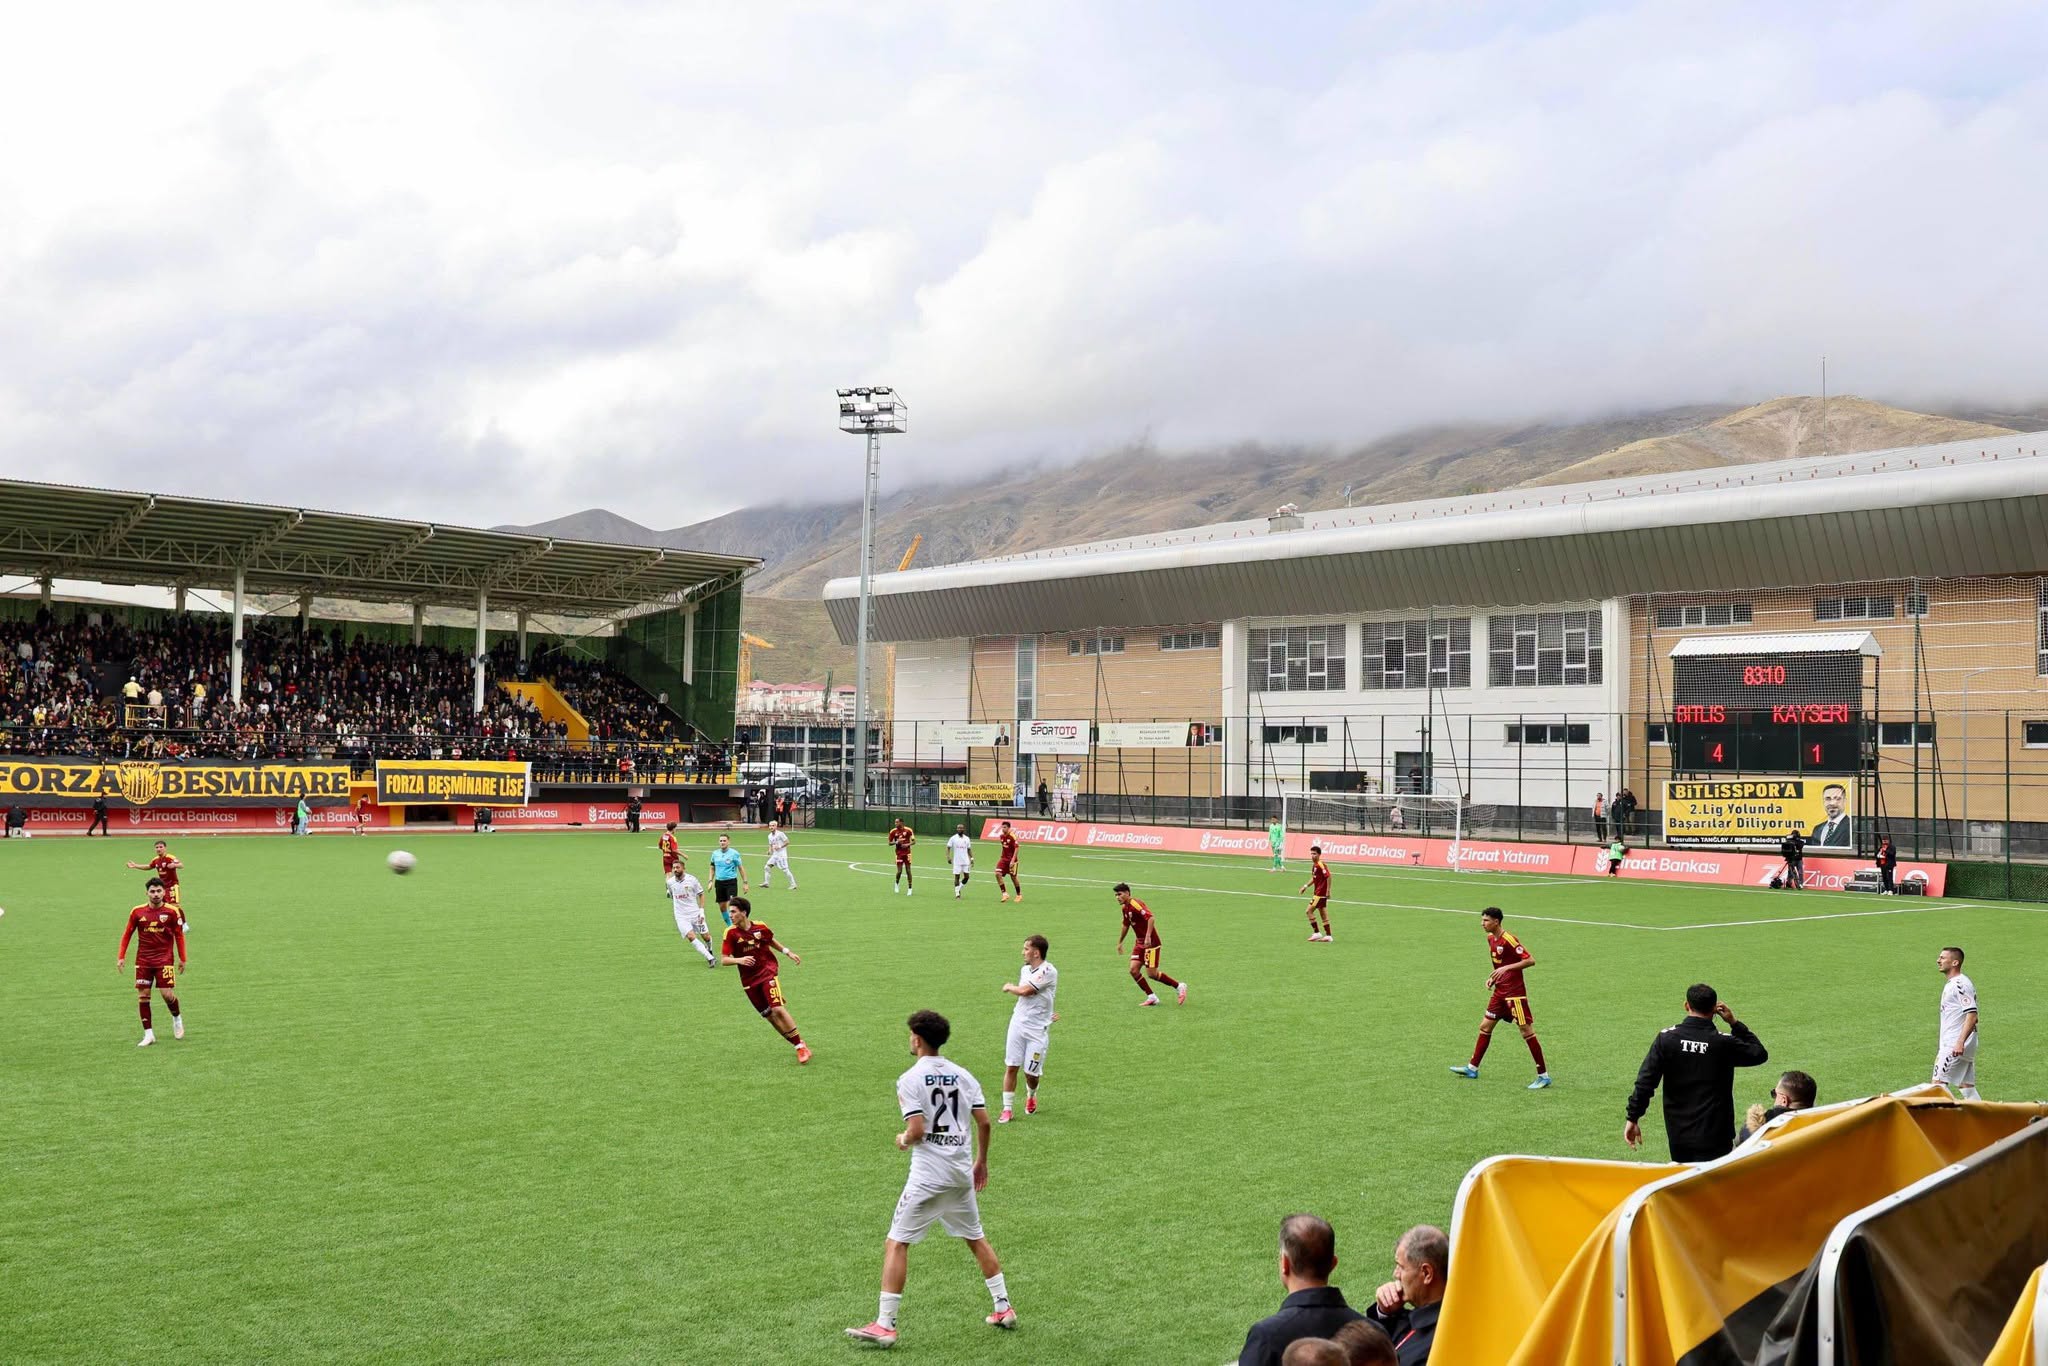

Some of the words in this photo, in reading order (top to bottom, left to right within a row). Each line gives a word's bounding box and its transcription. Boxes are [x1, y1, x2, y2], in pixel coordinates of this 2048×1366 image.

[1713, 743, 1723, 762] 4
[1812, 744, 1821, 762] 1
[386, 774, 424, 794] FORZA
[428, 773, 496, 800] BEŞMİNARE
[500, 774, 524, 797] LİSE
[31, 810, 86, 822] Bankası
[142, 810, 184, 822] Ziraat
[187, 810, 237, 822] Bankası
[491, 808, 517, 819] iraat
[518, 808, 558, 819] Bankası
[598, 809, 627, 820] Ziraat
[640, 809, 666, 819] nkası
[1690, 804, 1723, 816] 2.Lig
[1728, 804, 1782, 815] Yolunda
[1670, 818, 1731, 830] Başarılar
[1737, 818, 1805, 830] Diliyorum
[1095, 832, 1125, 843] Ziraat
[1126, 833, 1163, 845] Bankası
[1209, 835, 1244, 848] Ziraat
[1245, 838, 1269, 850] GYO
[1321, 841, 1357, 855] Ziraat
[1359, 843, 1406, 859] Bankası
[1458, 847, 1500, 862] Ziraat
[1501, 852, 1549, 865] Yatırım
[1620, 855, 1657, 870] iraat
[1659, 857, 1720, 874] Bankası
[162, 967, 174, 979] 26
[1680, 1039, 1709, 1054] TFF
[1028, 1060, 1039, 1072] 17
[931, 1087, 961, 1133] 21
